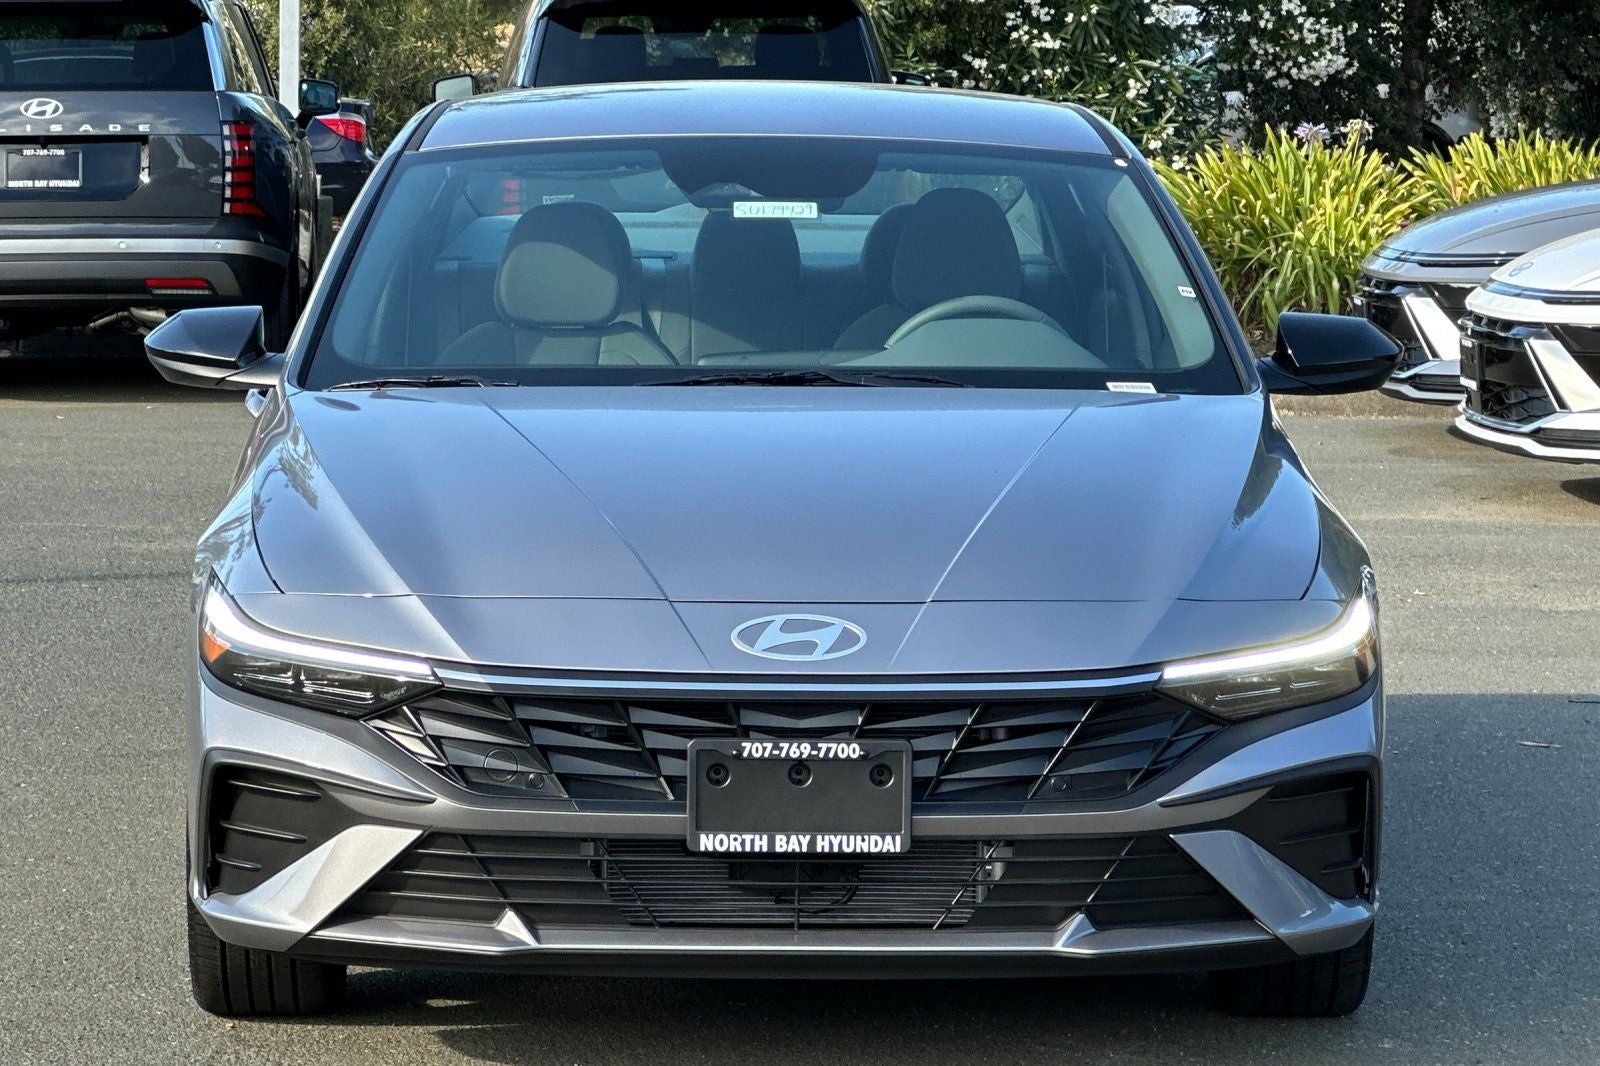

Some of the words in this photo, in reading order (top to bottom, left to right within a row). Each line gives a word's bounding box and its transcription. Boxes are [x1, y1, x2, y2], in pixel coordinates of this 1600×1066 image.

[741, 742, 860, 759] 707-769-7700
[700, 834, 768, 852] NORTH
[775, 834, 810, 852] BAY
[816, 834, 901, 852] HYUNDAI
